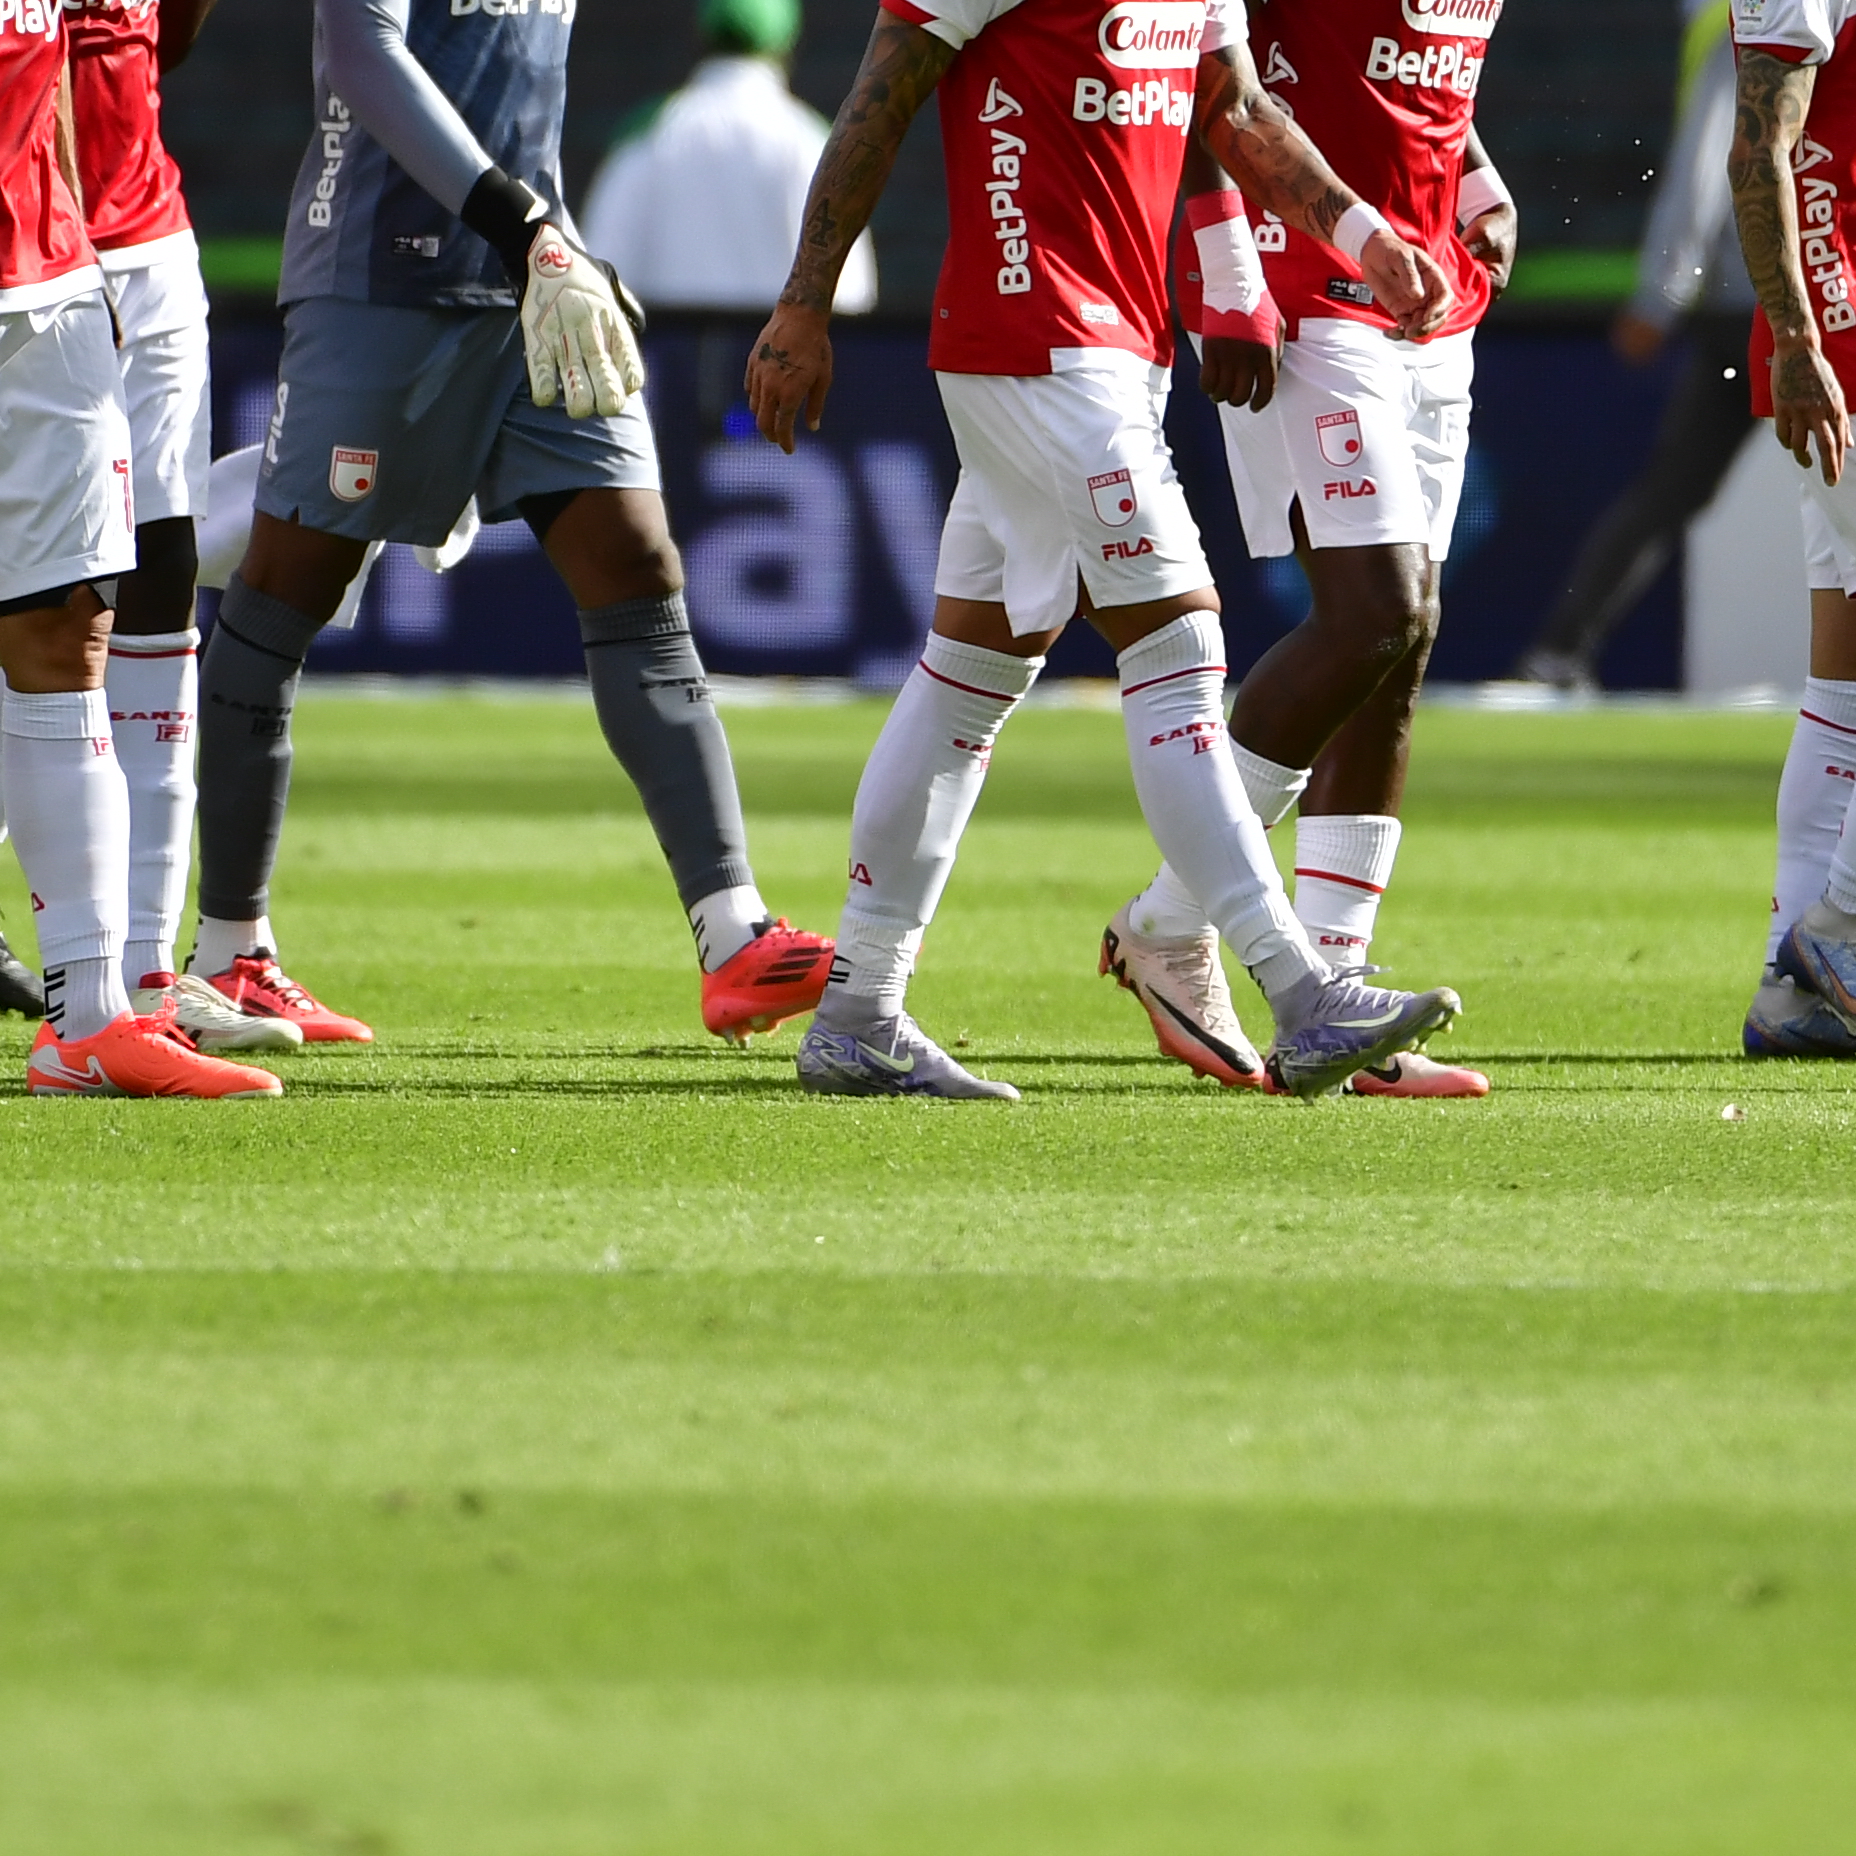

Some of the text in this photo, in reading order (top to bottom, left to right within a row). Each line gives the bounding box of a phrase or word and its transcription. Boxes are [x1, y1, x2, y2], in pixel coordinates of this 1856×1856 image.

[985, 128, 1031, 295] BetPlay
[1317, 411, 1356, 427] SANTA FE
[1090, 470, 1128, 487] SANTA FE
[1324, 478, 1377, 501] FILA
[1101, 536, 1154, 562] FILA
